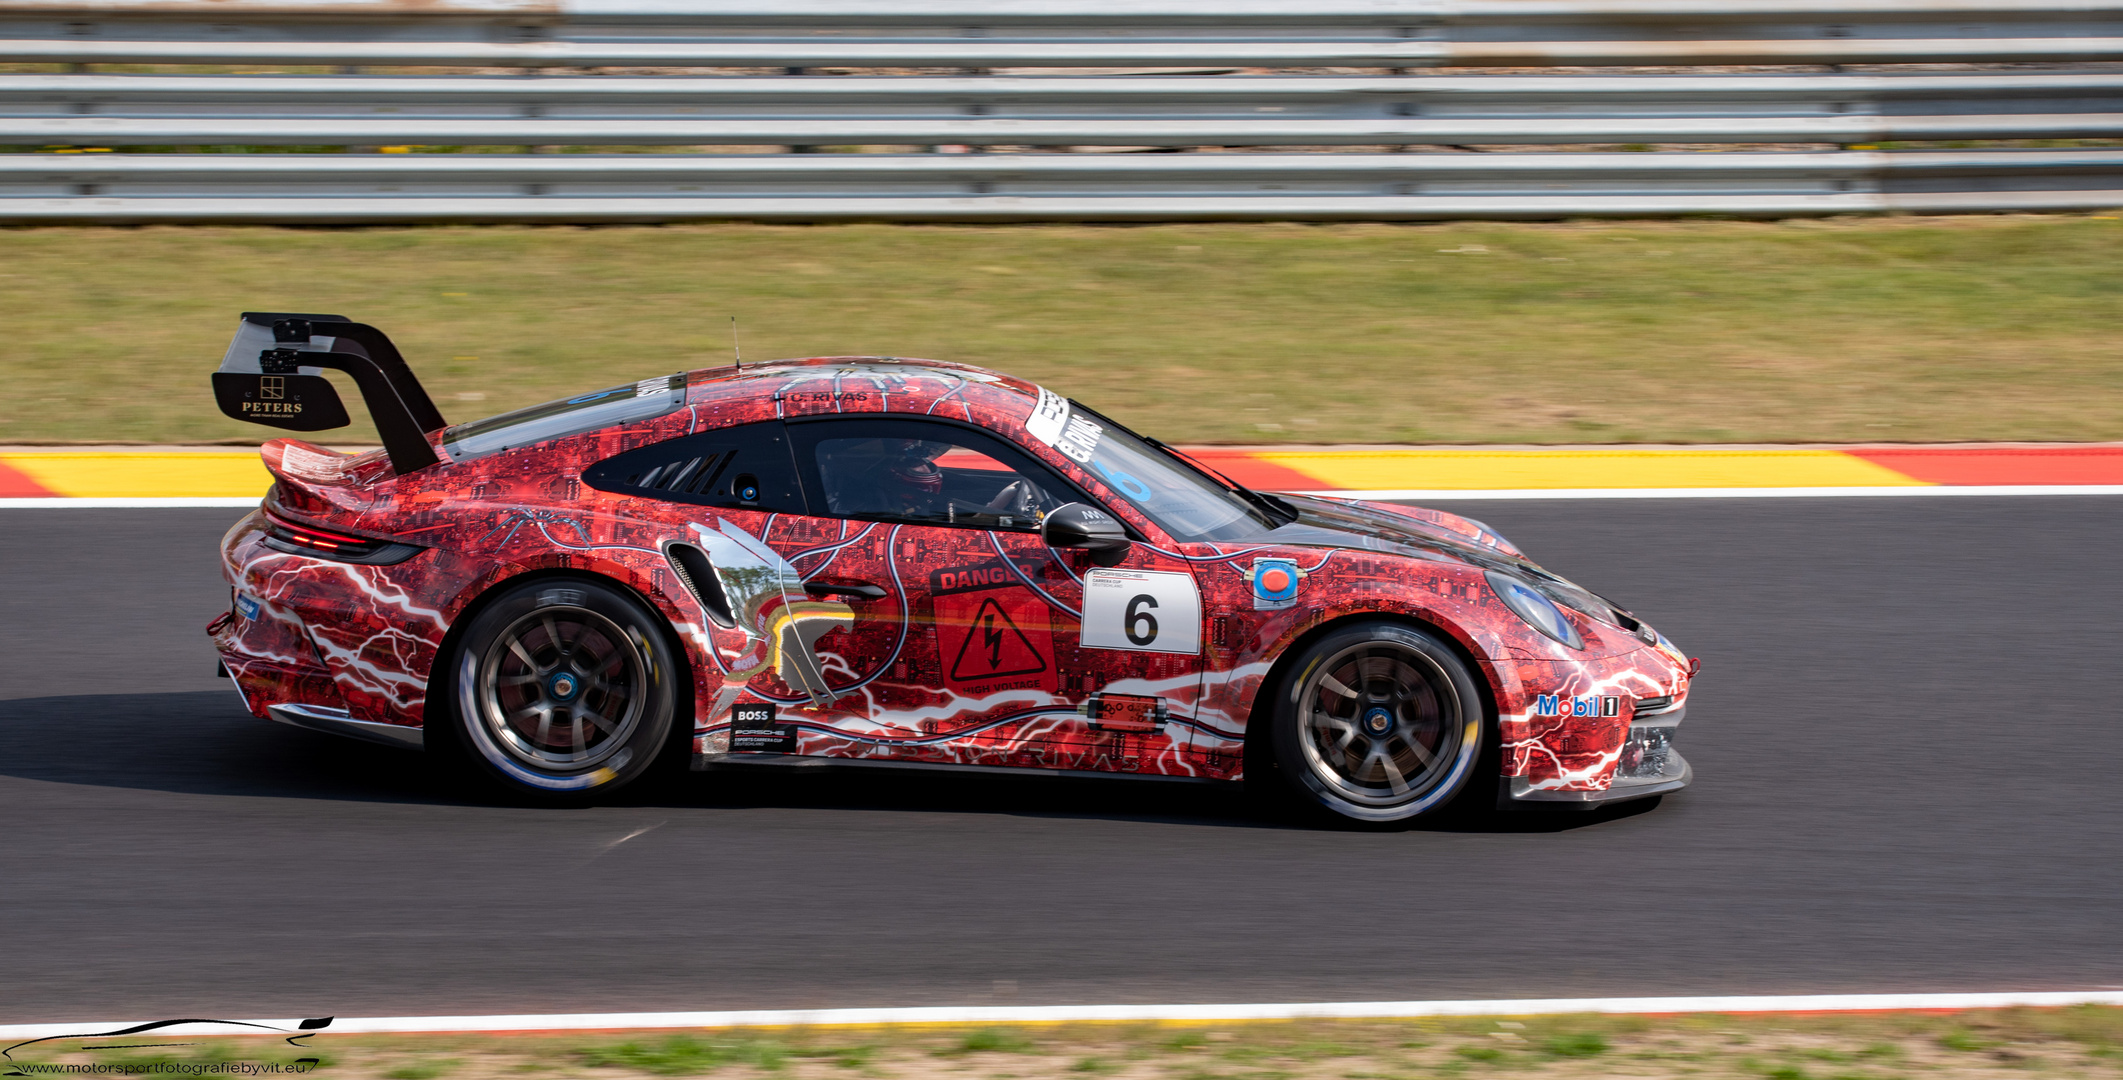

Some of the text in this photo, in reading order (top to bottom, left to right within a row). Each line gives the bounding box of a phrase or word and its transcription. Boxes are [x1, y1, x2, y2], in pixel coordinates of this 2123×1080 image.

[242, 402, 303, 413] PETERS
[813, 392, 868, 402] RIVAS
[1064, 413, 1103, 452] RIVAS
[1093, 460, 1152, 502] 6
[940, 564, 1035, 590] DANGER
[1124, 594, 1159, 646] 6
[963, 680, 1040, 695] HIGH VOLTAGE
[738, 711, 769, 720] BOSS
[1538, 695, 1599, 717] Mobil
[856, 738, 1139, 771] MISSION RIVAS
